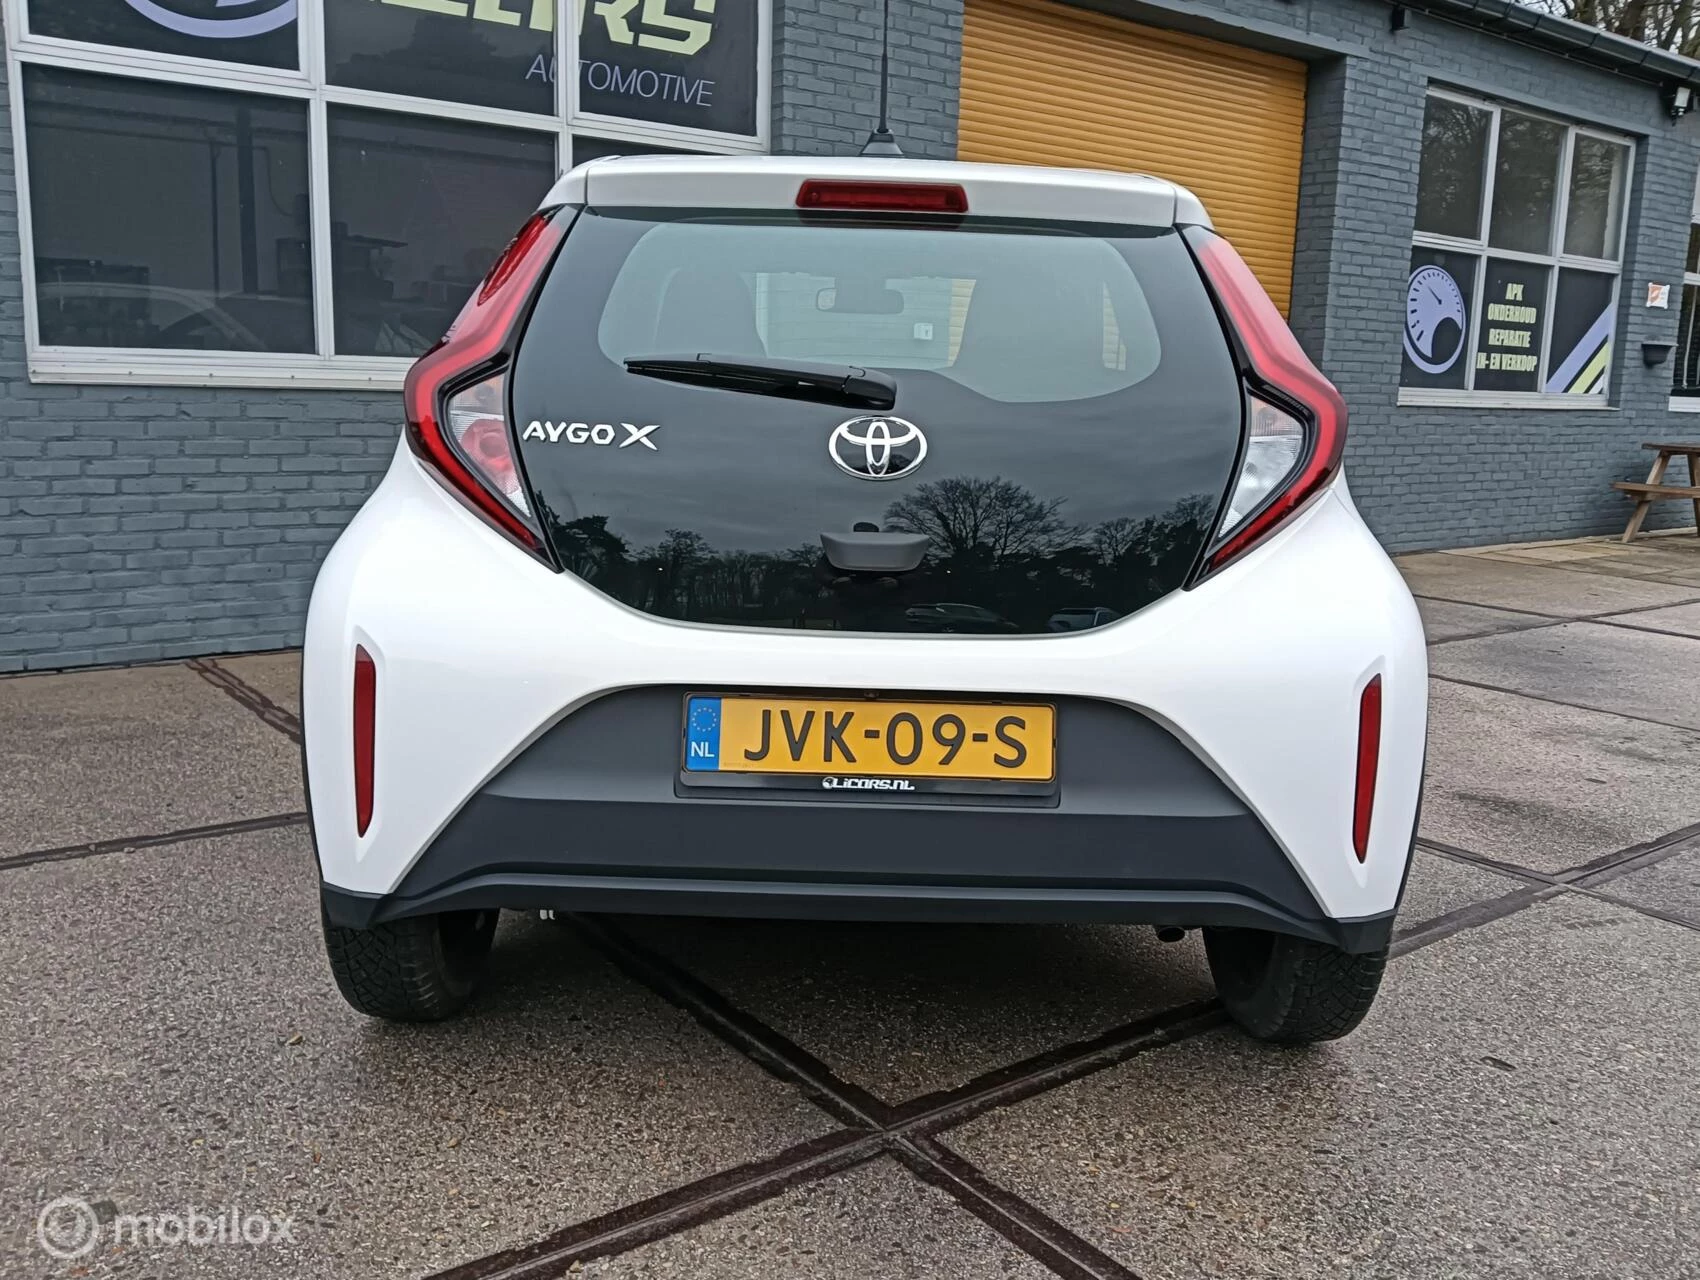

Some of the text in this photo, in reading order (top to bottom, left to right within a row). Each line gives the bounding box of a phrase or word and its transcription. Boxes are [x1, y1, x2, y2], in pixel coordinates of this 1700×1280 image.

[1505, 283, 1524, 301] APK
[1487, 303, 1537, 324] ONDERHOUD
[1488, 328, 1532, 348] REPARATIE
[1501, 353, 1538, 372] VERKOOP
[522, 420, 661, 451] AYGO X
[743, 708, 1028, 769] JVK-09-S
[690, 741, 715, 758] NL
